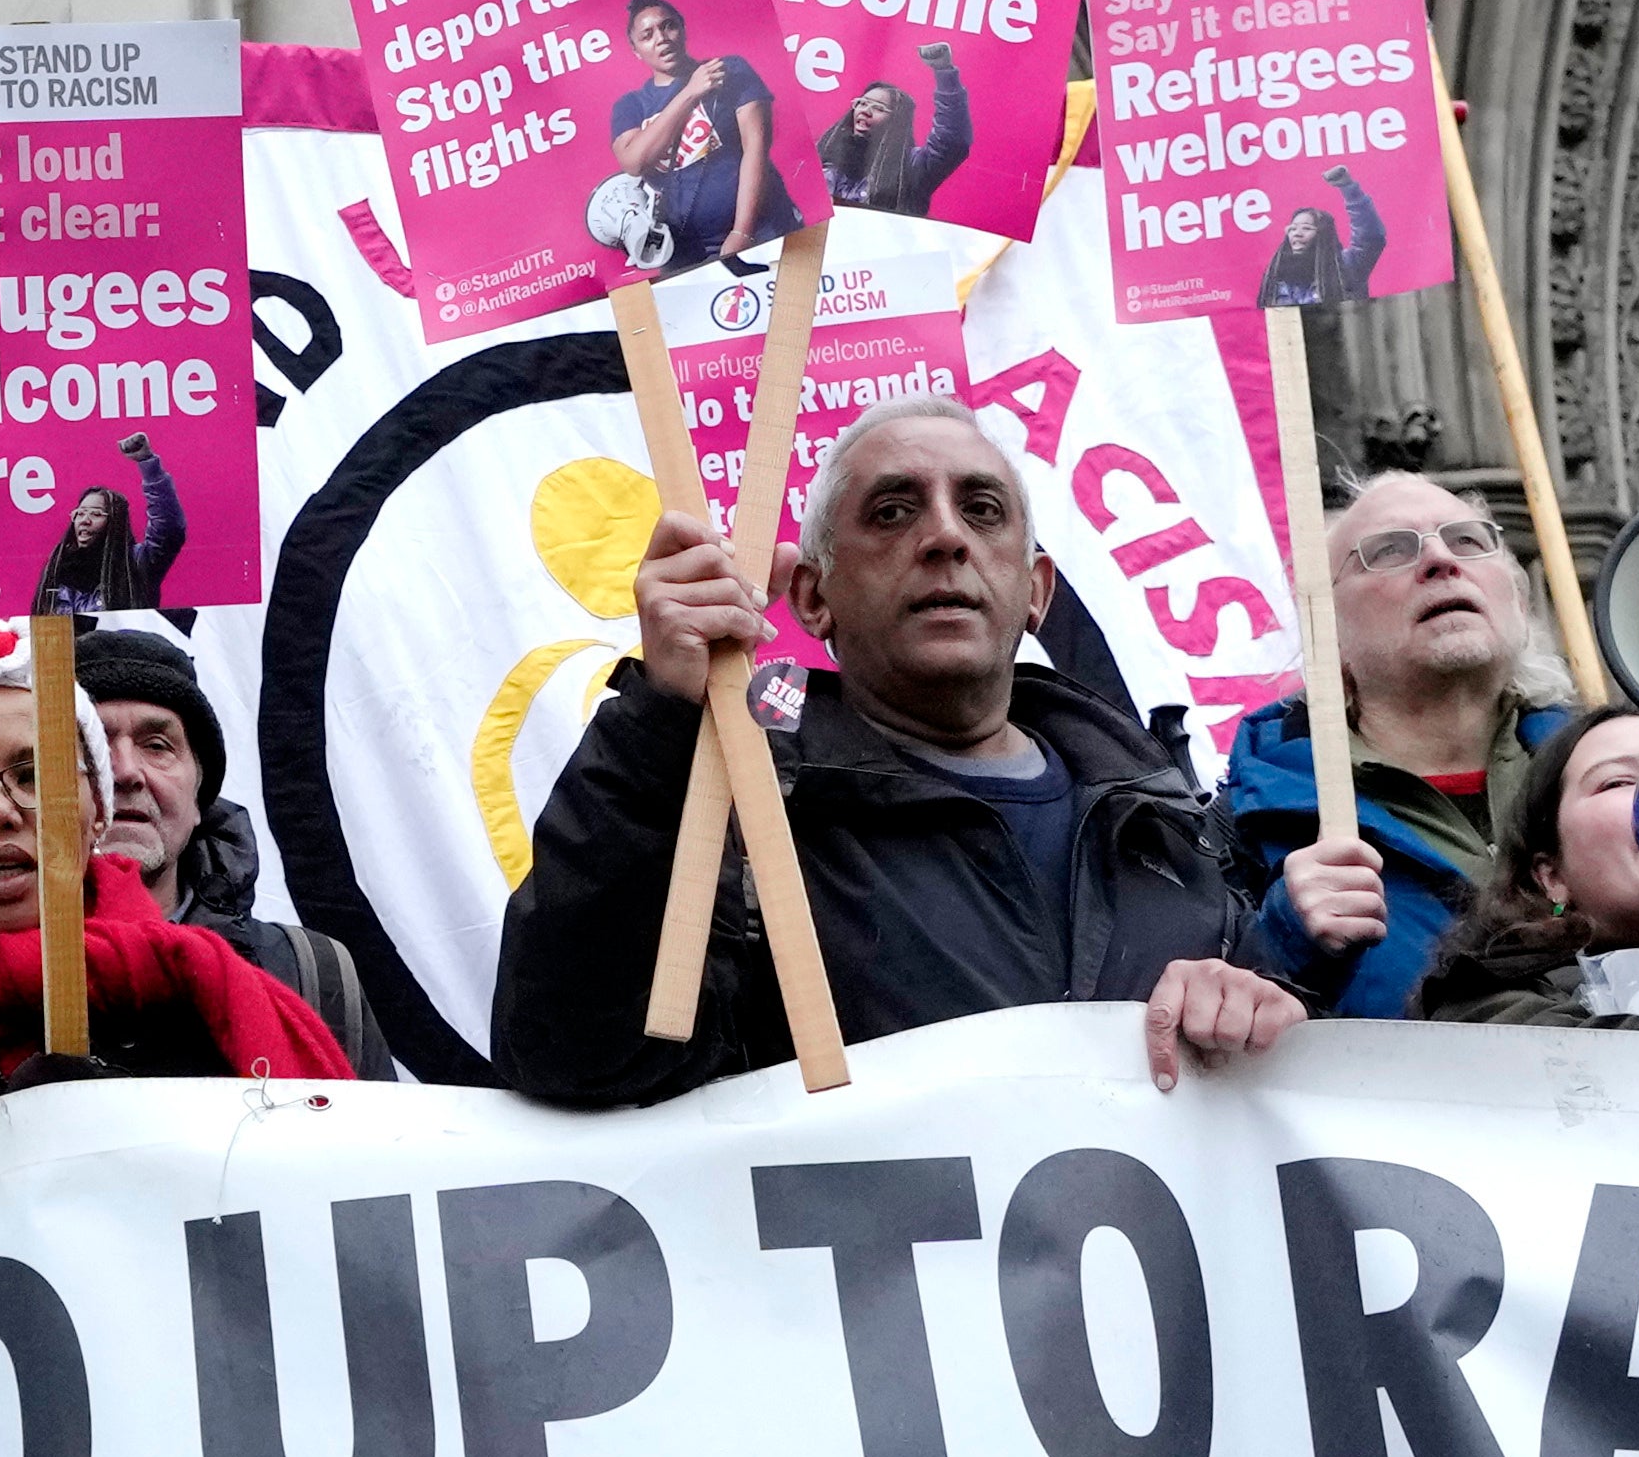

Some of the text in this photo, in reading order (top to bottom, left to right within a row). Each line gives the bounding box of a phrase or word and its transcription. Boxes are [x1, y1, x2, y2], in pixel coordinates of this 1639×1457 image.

[0, 43, 140, 74] STAND UP
[394, 30, 611, 133] Stop the
[1109, 38, 1414, 122] Refugees
[0, 76, 157, 108] TO RACISM
[18, 133, 123, 182] loud
[408, 102, 576, 196] flights
[1115, 106, 1406, 184] welcome
[1122, 189, 1271, 251] here
[454, 247, 557, 297] @StandUTR
[460, 257, 598, 318] @AntiRacismDay
